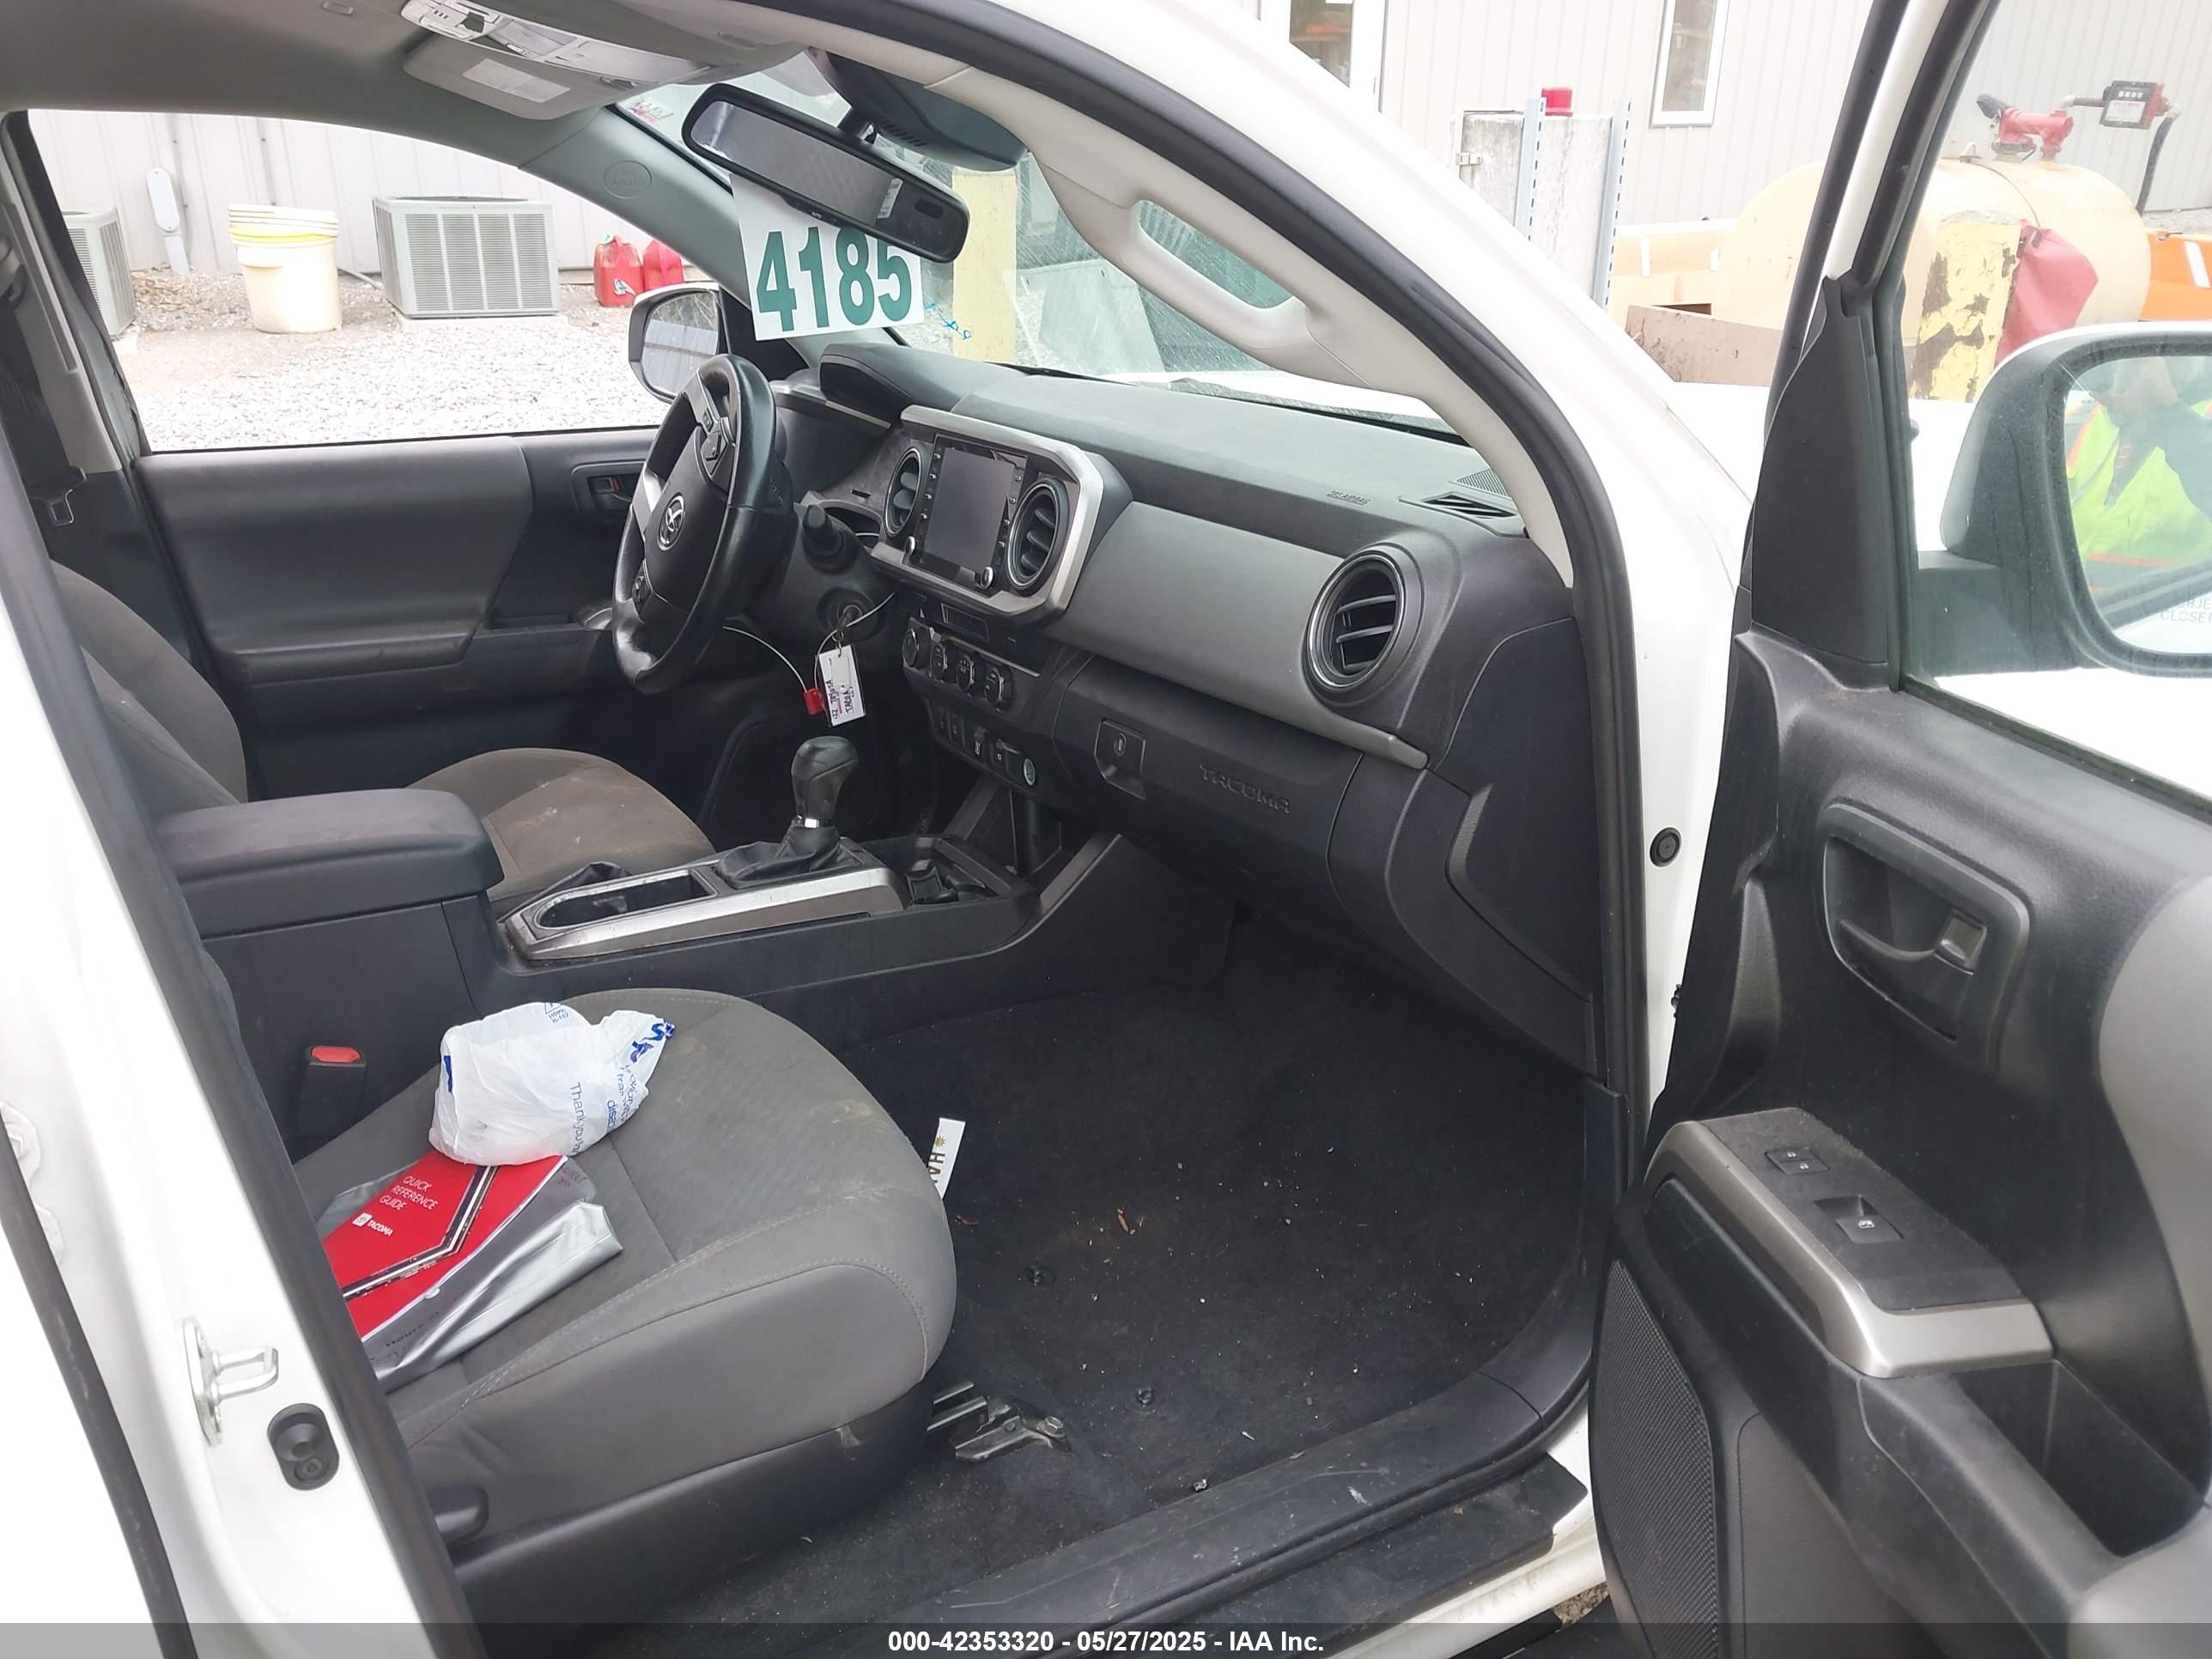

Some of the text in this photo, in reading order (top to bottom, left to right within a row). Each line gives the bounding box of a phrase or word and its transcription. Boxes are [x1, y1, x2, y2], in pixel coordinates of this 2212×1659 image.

[757, 226, 912, 332] 4185
[1195, 763, 1291, 815] TACOMA
[402, 1176, 432, 1192] QUICK
[379, 1194, 408, 1212] GUIDE
[391, 1184, 439, 1211] REFERENCE
[367, 1218, 394, 1237] TACOMA
